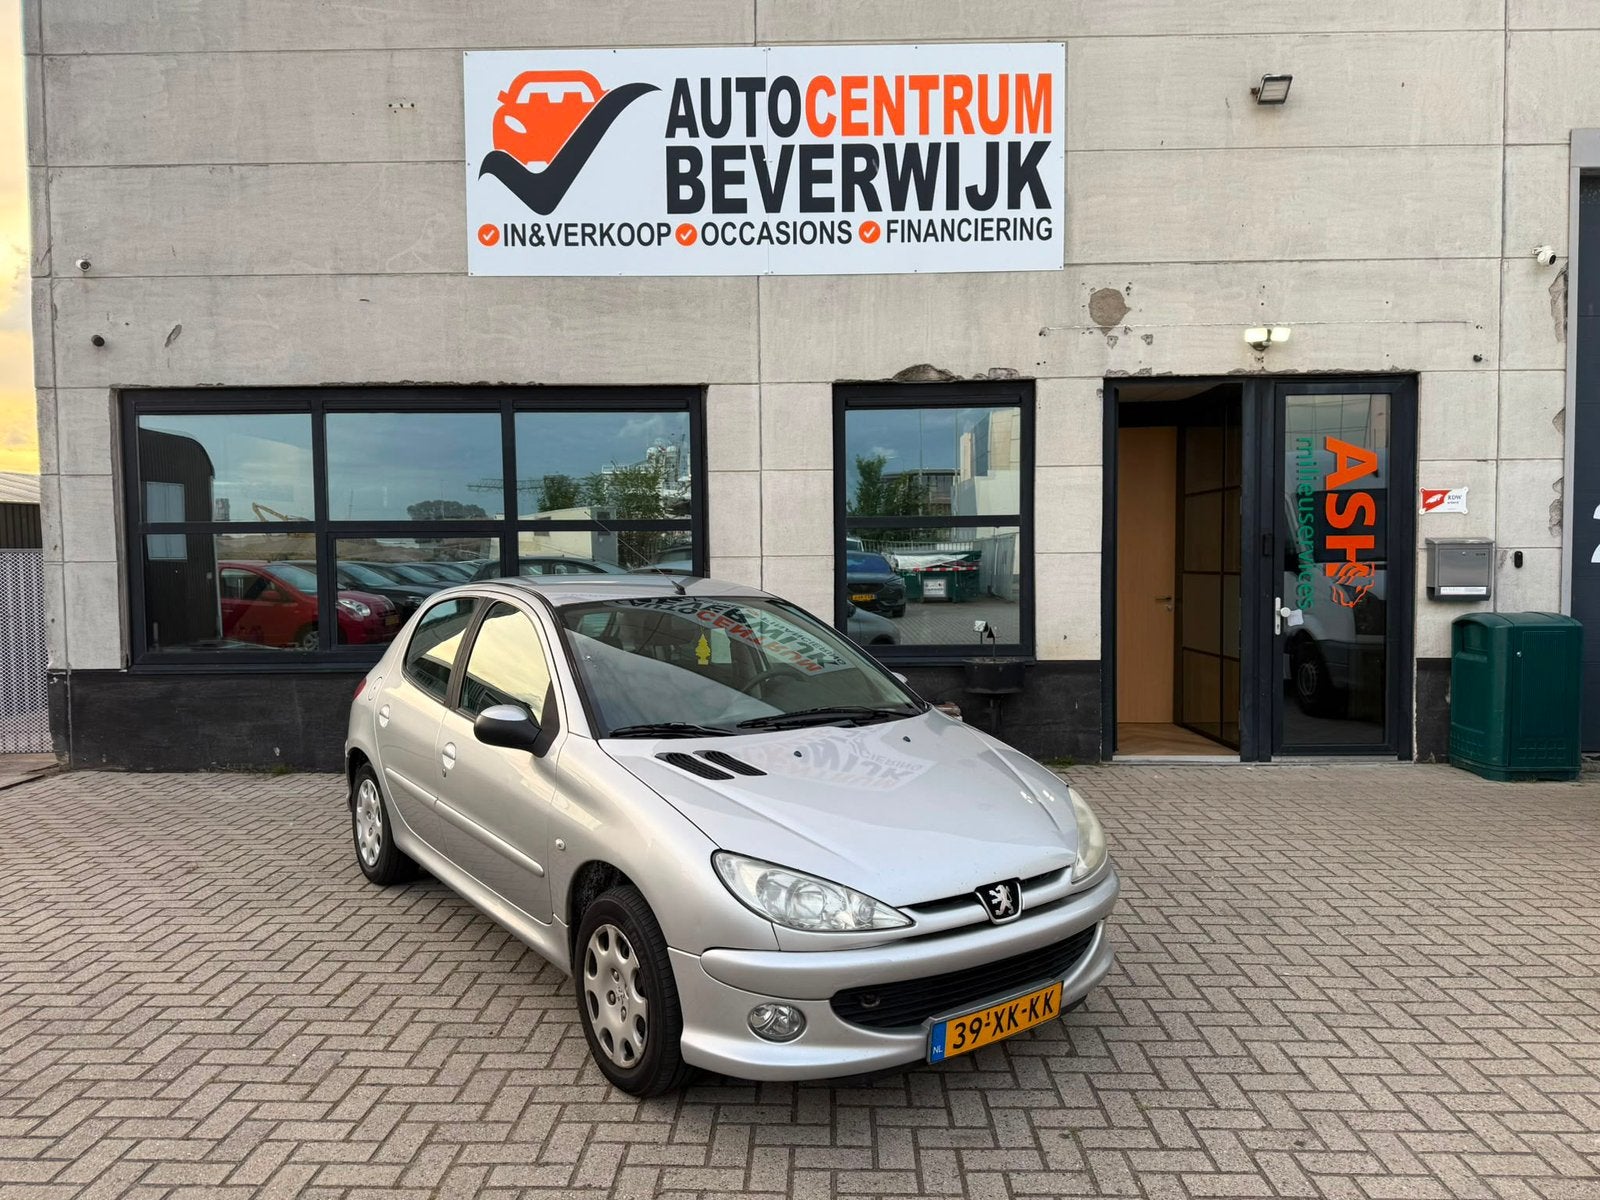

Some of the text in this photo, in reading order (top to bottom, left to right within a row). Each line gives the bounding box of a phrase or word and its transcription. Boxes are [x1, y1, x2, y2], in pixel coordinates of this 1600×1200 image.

[665, 73, 1052, 139] AUTOCENTRUM
[665, 141, 1052, 215] BEVERWIJK
[503, 217, 1053, 247] IN&VERKOOP OCCASIONS FINANCIERING
[1297, 437, 1320, 609] milieuservices
[1325, 435, 1378, 578] ASH
[932, 1045, 944, 1054] NL
[952, 990, 1054, 1049] 39-XK-KK
